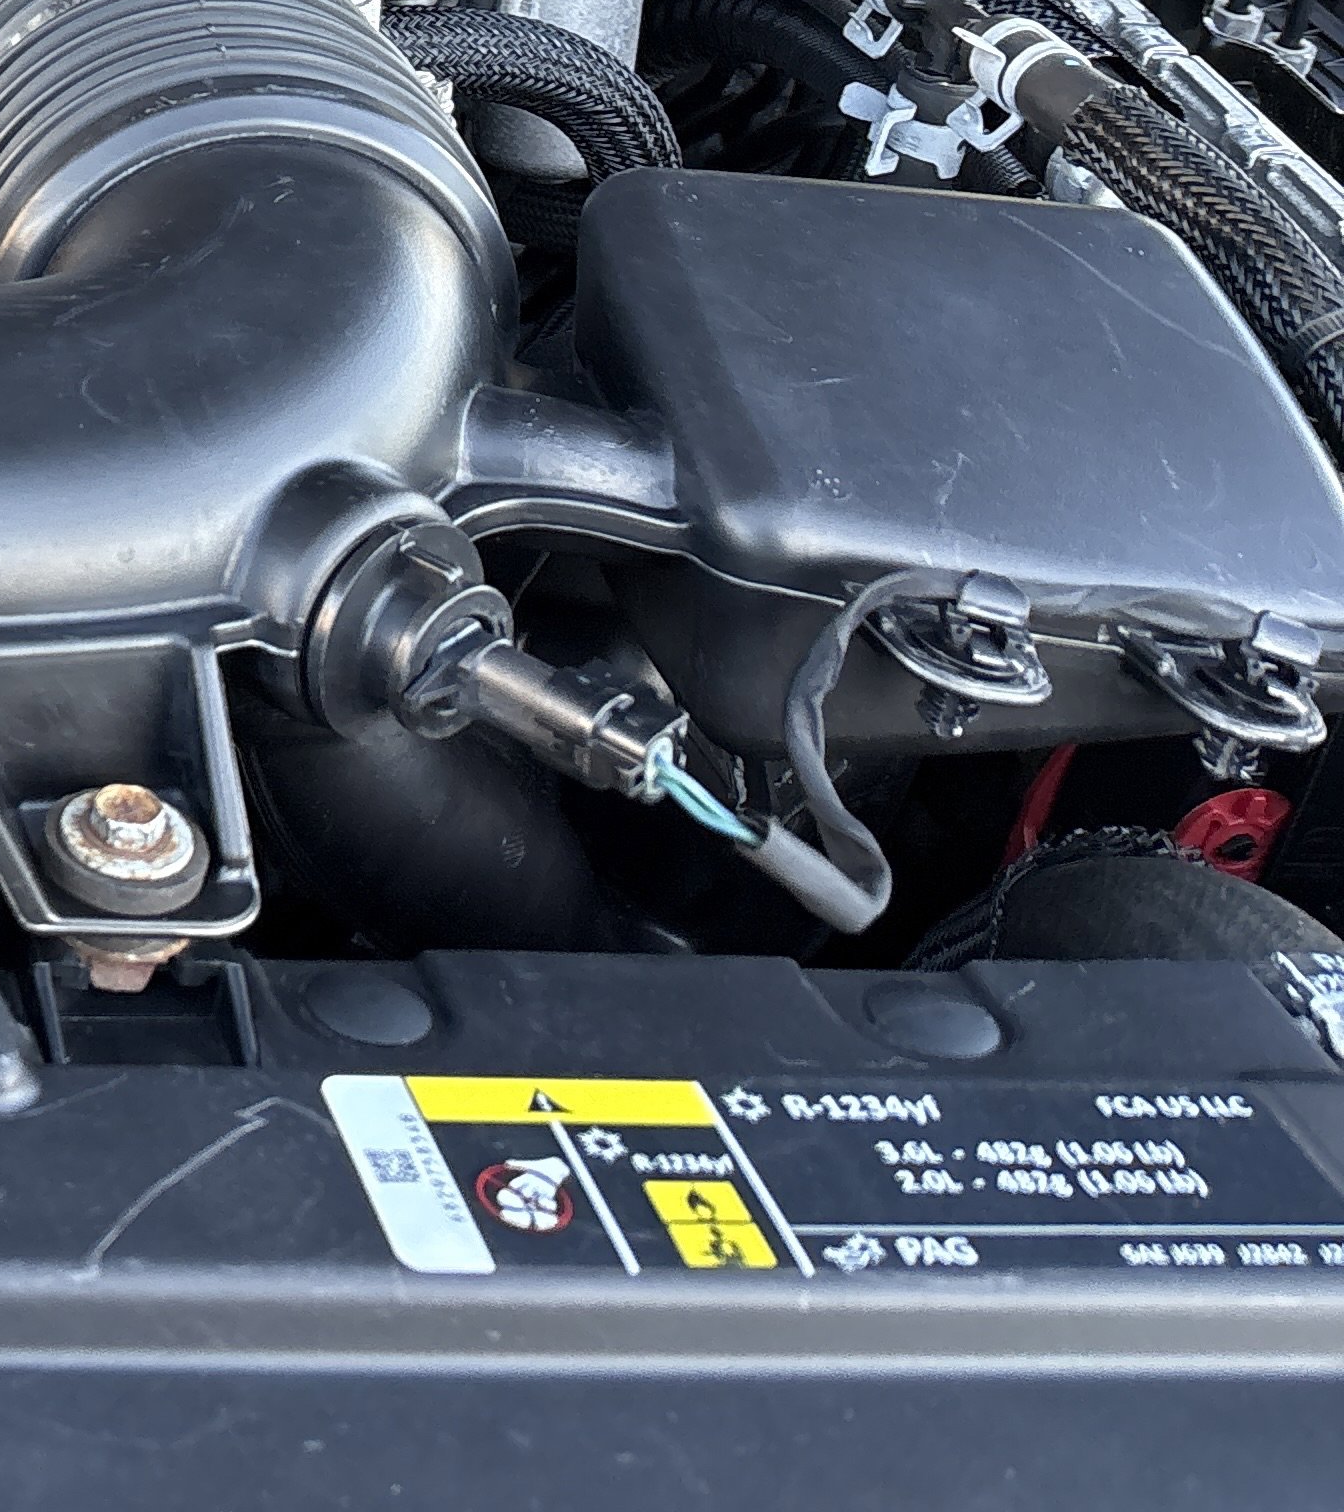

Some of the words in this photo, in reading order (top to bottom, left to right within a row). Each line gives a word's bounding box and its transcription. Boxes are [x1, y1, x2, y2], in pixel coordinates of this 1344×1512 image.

[781, 1093, 942, 1127] R-1234yf
[1095, 1094, 1158, 1119] FCA
[1155, 1094, 1201, 1119] US
[893, 1235, 980, 1267] PAG
